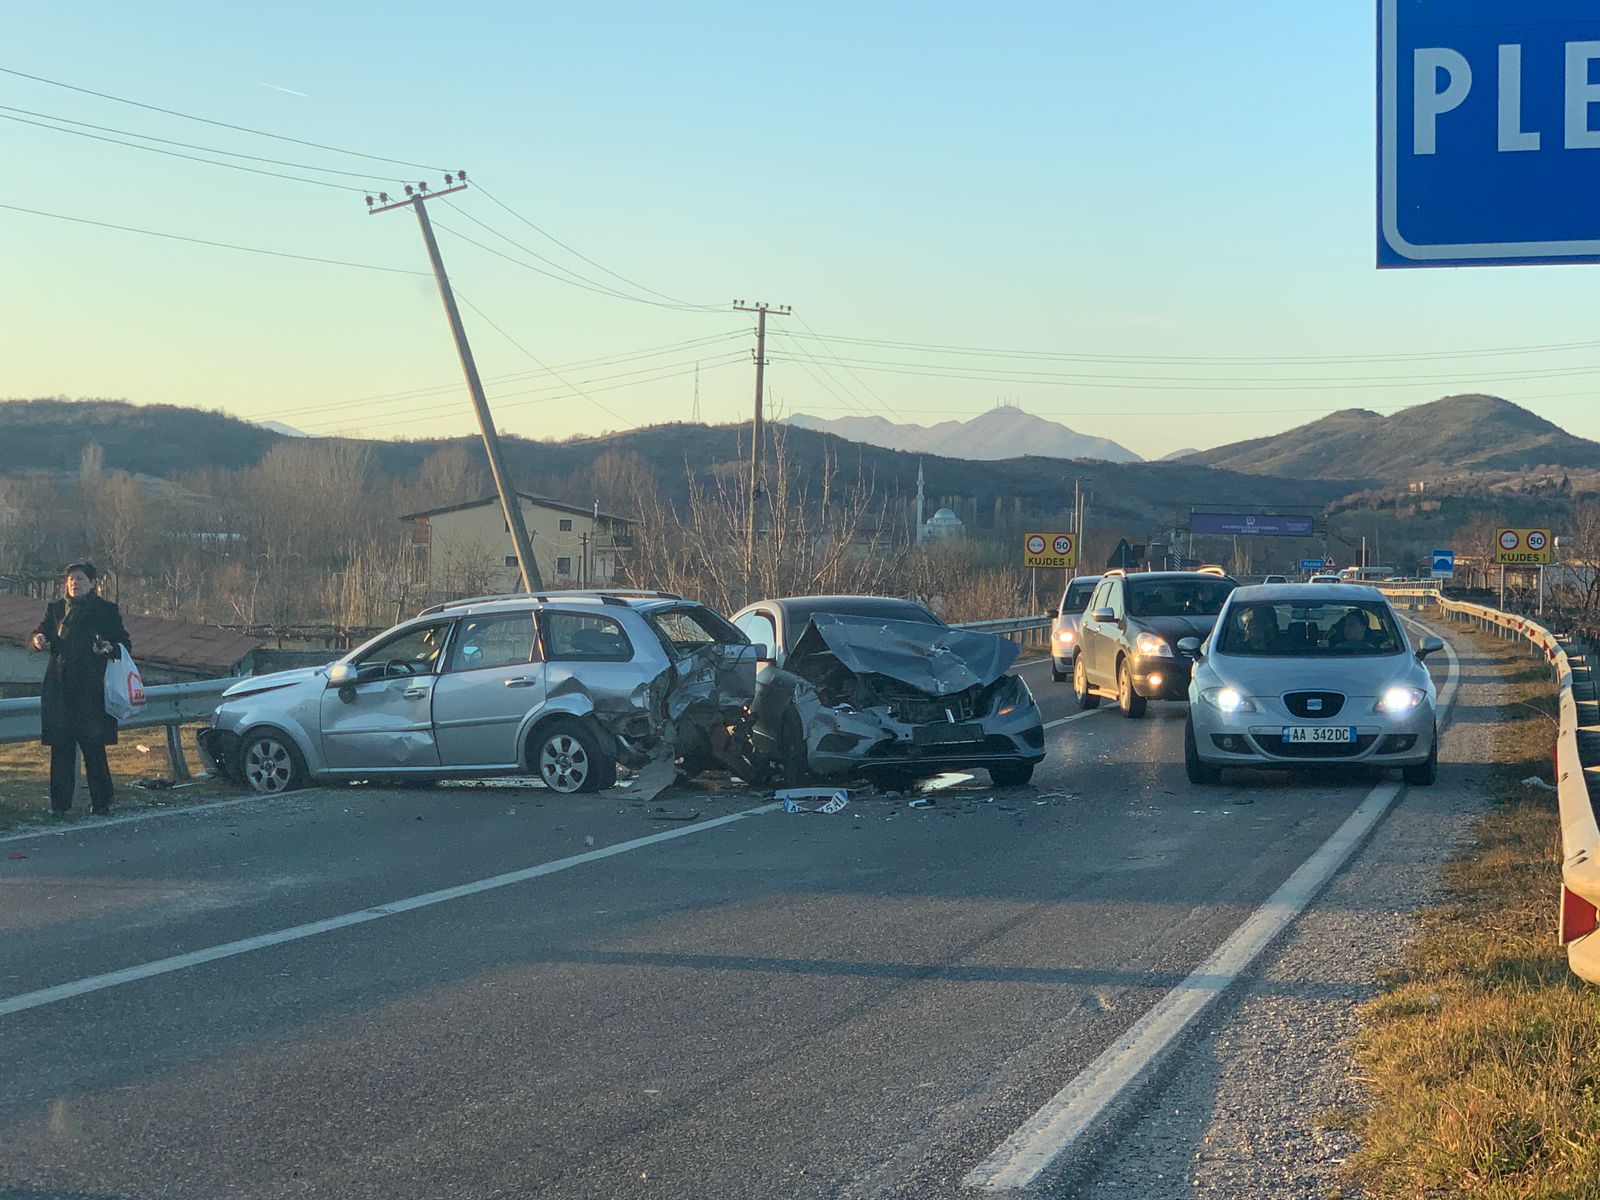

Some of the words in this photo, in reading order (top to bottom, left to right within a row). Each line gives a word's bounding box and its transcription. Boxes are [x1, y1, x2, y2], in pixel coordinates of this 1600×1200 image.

[1413, 41, 1600, 155] PLE
[1056, 541, 1069, 550] 50
[1530, 537, 1543, 545] 50
[1028, 557, 1065, 566] KUJDES
[1500, 553, 1540, 562] KUJDES
[1292, 728, 1306, 741] AA
[1312, 728, 1349, 741] 342DC
